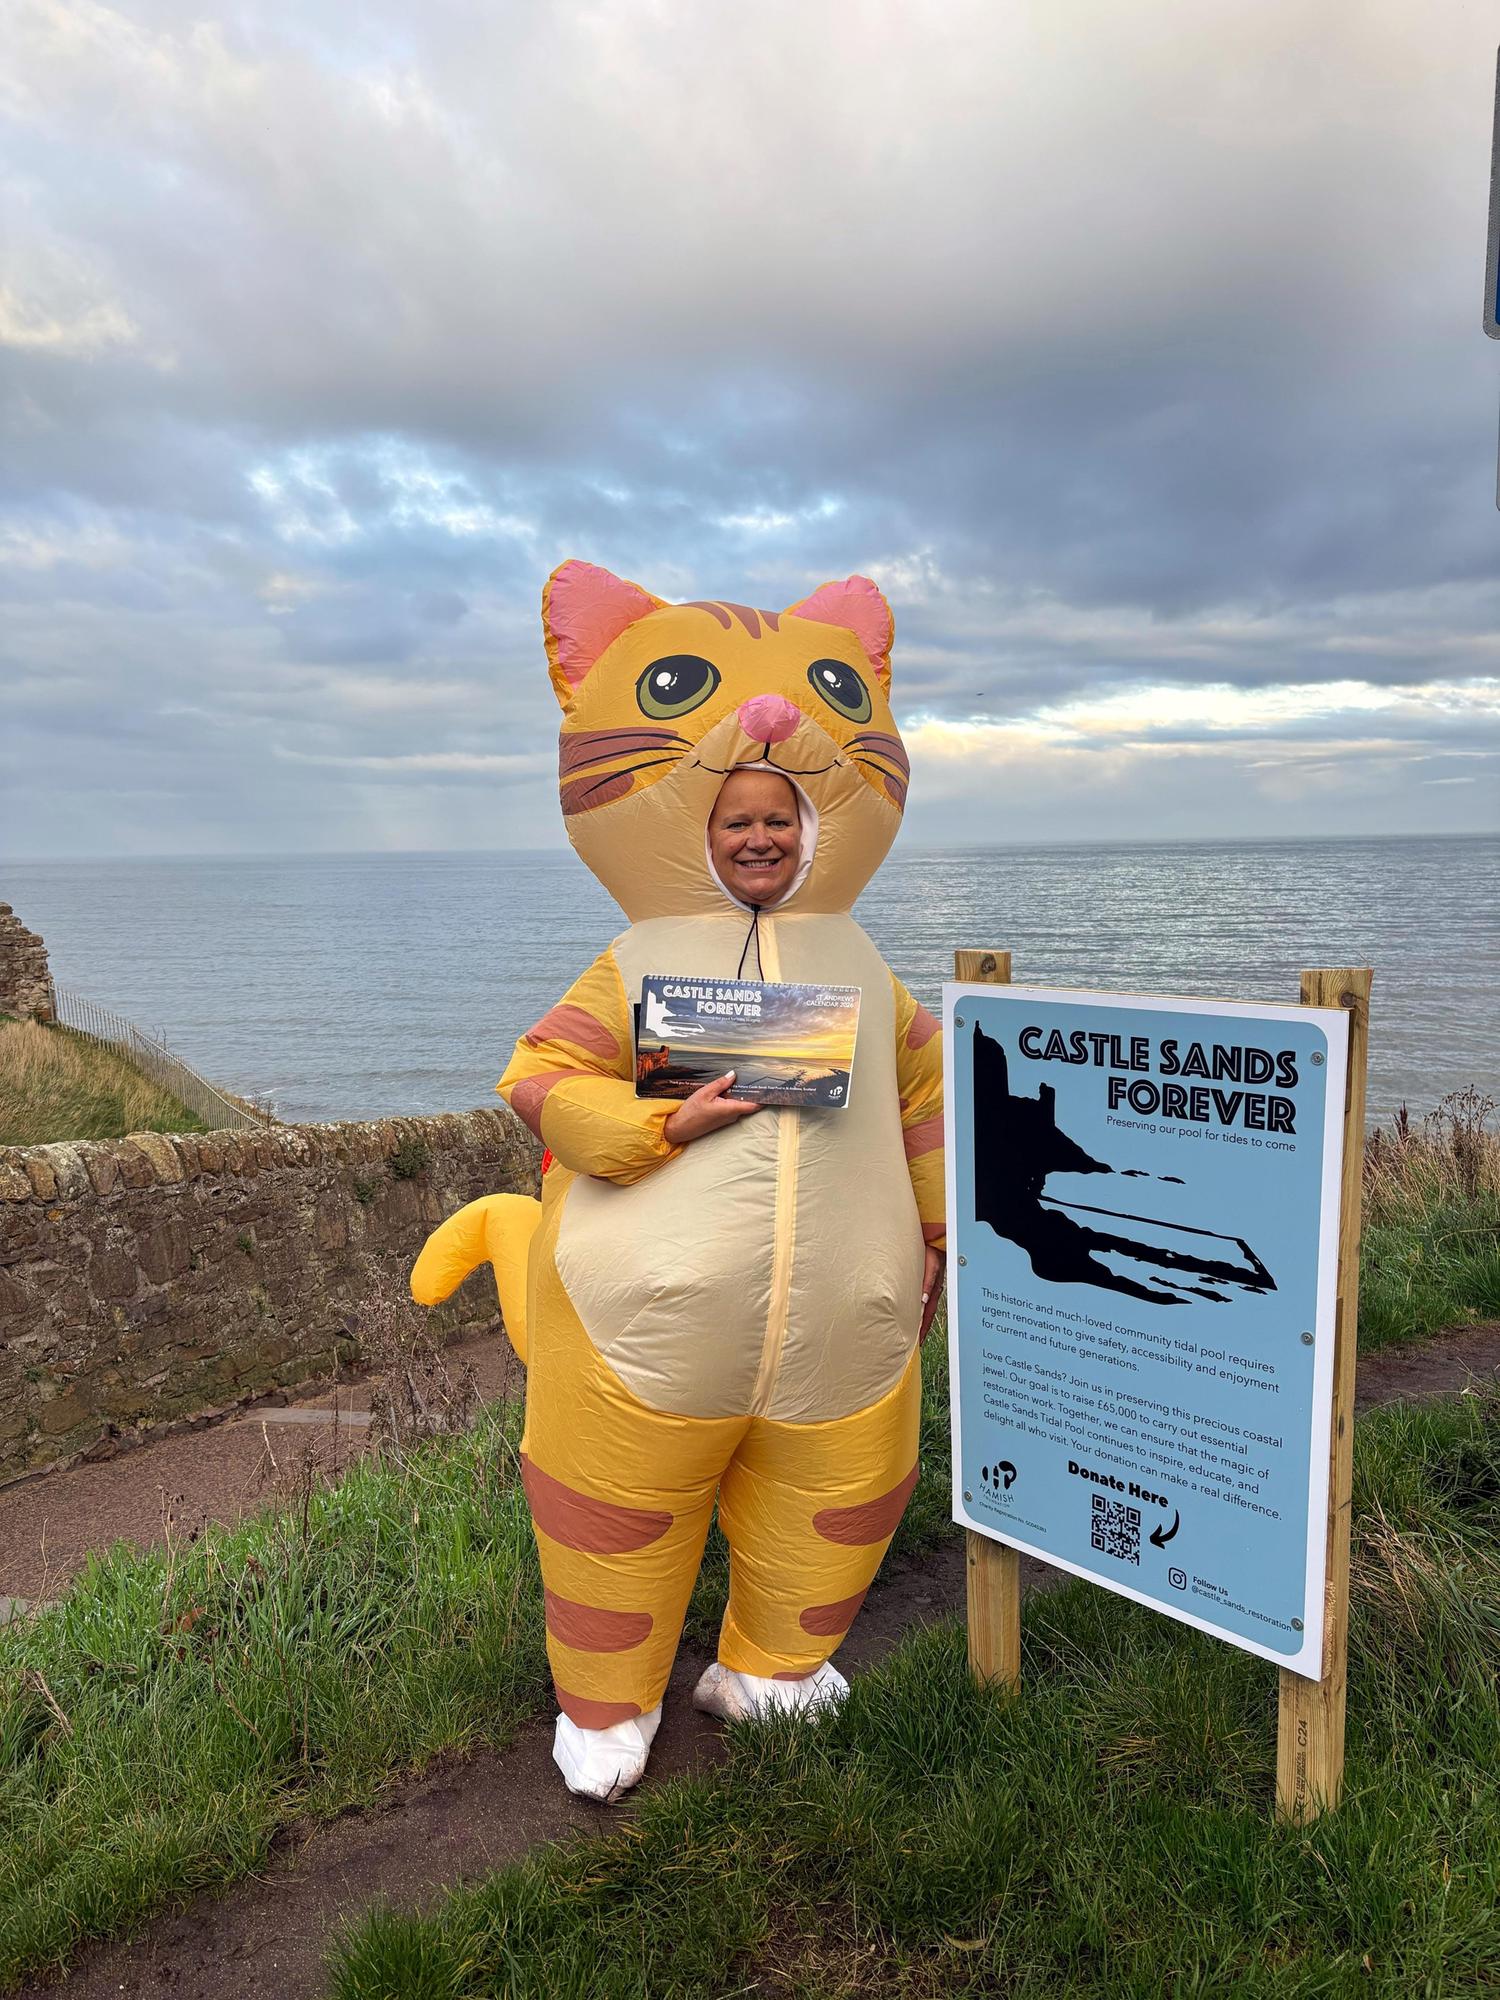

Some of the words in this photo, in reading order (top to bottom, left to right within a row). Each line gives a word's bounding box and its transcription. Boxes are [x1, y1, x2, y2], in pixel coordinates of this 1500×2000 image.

[663, 984, 713, 1000] CASTLE
[716, 988, 762, 1003] SANDS
[696, 1001, 762, 1016] FOREVER
[1019, 1026, 1149, 1072] CASTLE
[1160, 1039, 1299, 1089] SANDS
[1106, 1115, 1156, 1134] Preserving
[1159, 1125, 1176, 1134] our
[1178, 1127, 1202, 1139] pool
[1205, 1129, 1219, 1141] for
[1222, 1132, 1248, 1145] tides
[1251, 1136, 1263, 1147] to
[1265, 1140, 1296, 1152] come
[1108, 1076, 1297, 1135] FOREVER
[982, 1287, 999, 1301] This
[1001, 1292, 1033, 1310] historic
[1035, 1305, 1053, 1315] and
[1055, 1308, 1112, 1331] much-loved
[1115, 1324, 1171, 1349] community
[1174, 1339, 1197, 1353] tidal
[1200, 1348, 1226, 1361] pool
[1228, 1354, 1275, 1374] requires
[982, 1318, 994, 1329] for
[996, 1324, 1028, 1340] current
[1029, 1333, 1047, 1345] and
[1049, 1337, 1077, 1354] future
[1079, 1349, 1140, 1372] generations.
[982, 1305, 1010, 1320] urgent
[1012, 1313, 1061, 1333] renovation
[1063, 1326, 1073, 1336] to
[1075, 1330, 1096, 1343] give
[1098, 1337, 1129, 1354] safety,
[1131, 1345, 1193, 1372] accessibility
[1196, 1364, 1216, 1376] and
[1219, 1369, 1280, 1394] enjoyment
[982, 1348, 1003, 1363] Love
[1005, 1355, 1033, 1372] Castle
[1034, 1365, 1067, 1382] Sands?
[1069, 1376, 1089, 1390] Join
[1091, 1384, 1102, 1394] us
[1105, 1386, 1114, 1397] in
[1116, 1391, 1169, 1416] preserving
[1172, 1407, 1191, 1421] this
[1193, 1415, 1240, 1435] precious
[1243, 1430, 1283, 1448] coastal
[982, 1363, 1007, 1378] jewel.
[1009, 1372, 1026, 1386] Our
[1029, 1379, 1049, 1393] goal
[1051, 1385, 1059, 1396] is
[1060, 1388, 1070, 1399] to
[1072, 1394, 1095, 1407] raise
[1097, 1399, 1137, 1421] £65,000
[1139, 1413, 1150, 1425] to
[1152, 1419, 1178, 1436] carry
[1180, 1428, 1198, 1440] out
[1200, 1435, 1248, 1455] essential
[983, 1379, 1030, 1401] restoration
[1031, 1395, 1056, 1411] work.
[1057, 1402, 1102, 1427] Together,
[1104, 1419, 1119, 1431] we
[1120, 1425, 1138, 1438] can
[1140, 1432, 1175, 1449] ensure
[1178, 1442, 1198, 1457] that
[1200, 1449, 1218, 1463] the
[1221, 1457, 1254, 1476] magic
[1257, 1469, 1270, 1480] of
[983, 1393, 1010, 1411] Castle
[1011, 1403, 1039, 1420] Sands
[1040, 1412, 1063, 1428] Tidal
[1064, 1421, 1085, 1436] Pool
[1087, 1430, 1134, 1453] continues
[1136, 1446, 1147, 1457] to
[1149, 1448, 1186, 1471] inspire,
[1189, 1464, 1235, 1488] educate,
[1237, 1480, 1260, 1495] and
[979, 1483, 1015, 1503] HAMISH
[983, 1409, 1014, 1427] delight
[1016, 1421, 1026, 1432] all
[1028, 1425, 1047, 1438] who
[1049, 1433, 1069, 1447] visit.
[1071, 1438, 1092, 1454] Your
[1094, 1448, 1138, 1470] donation
[1140, 1464, 1158, 1477] can
[1160, 1471, 1189, 1488] make
[1190, 1481, 1198, 1491] a
[1200, 1484, 1220, 1499] real
[1223, 1492, 1283, 1521] difference.
[1068, 1460, 1126, 1492] Donate
[1128, 1482, 1169, 1508] Here
[1191, 1585, 1292, 1632] @castle_sands_restoration
[1193, 1576, 1217, 1592] Follow
[1219, 1586, 1229, 1596] Us
[1297, 1719, 1308, 1747] C24
